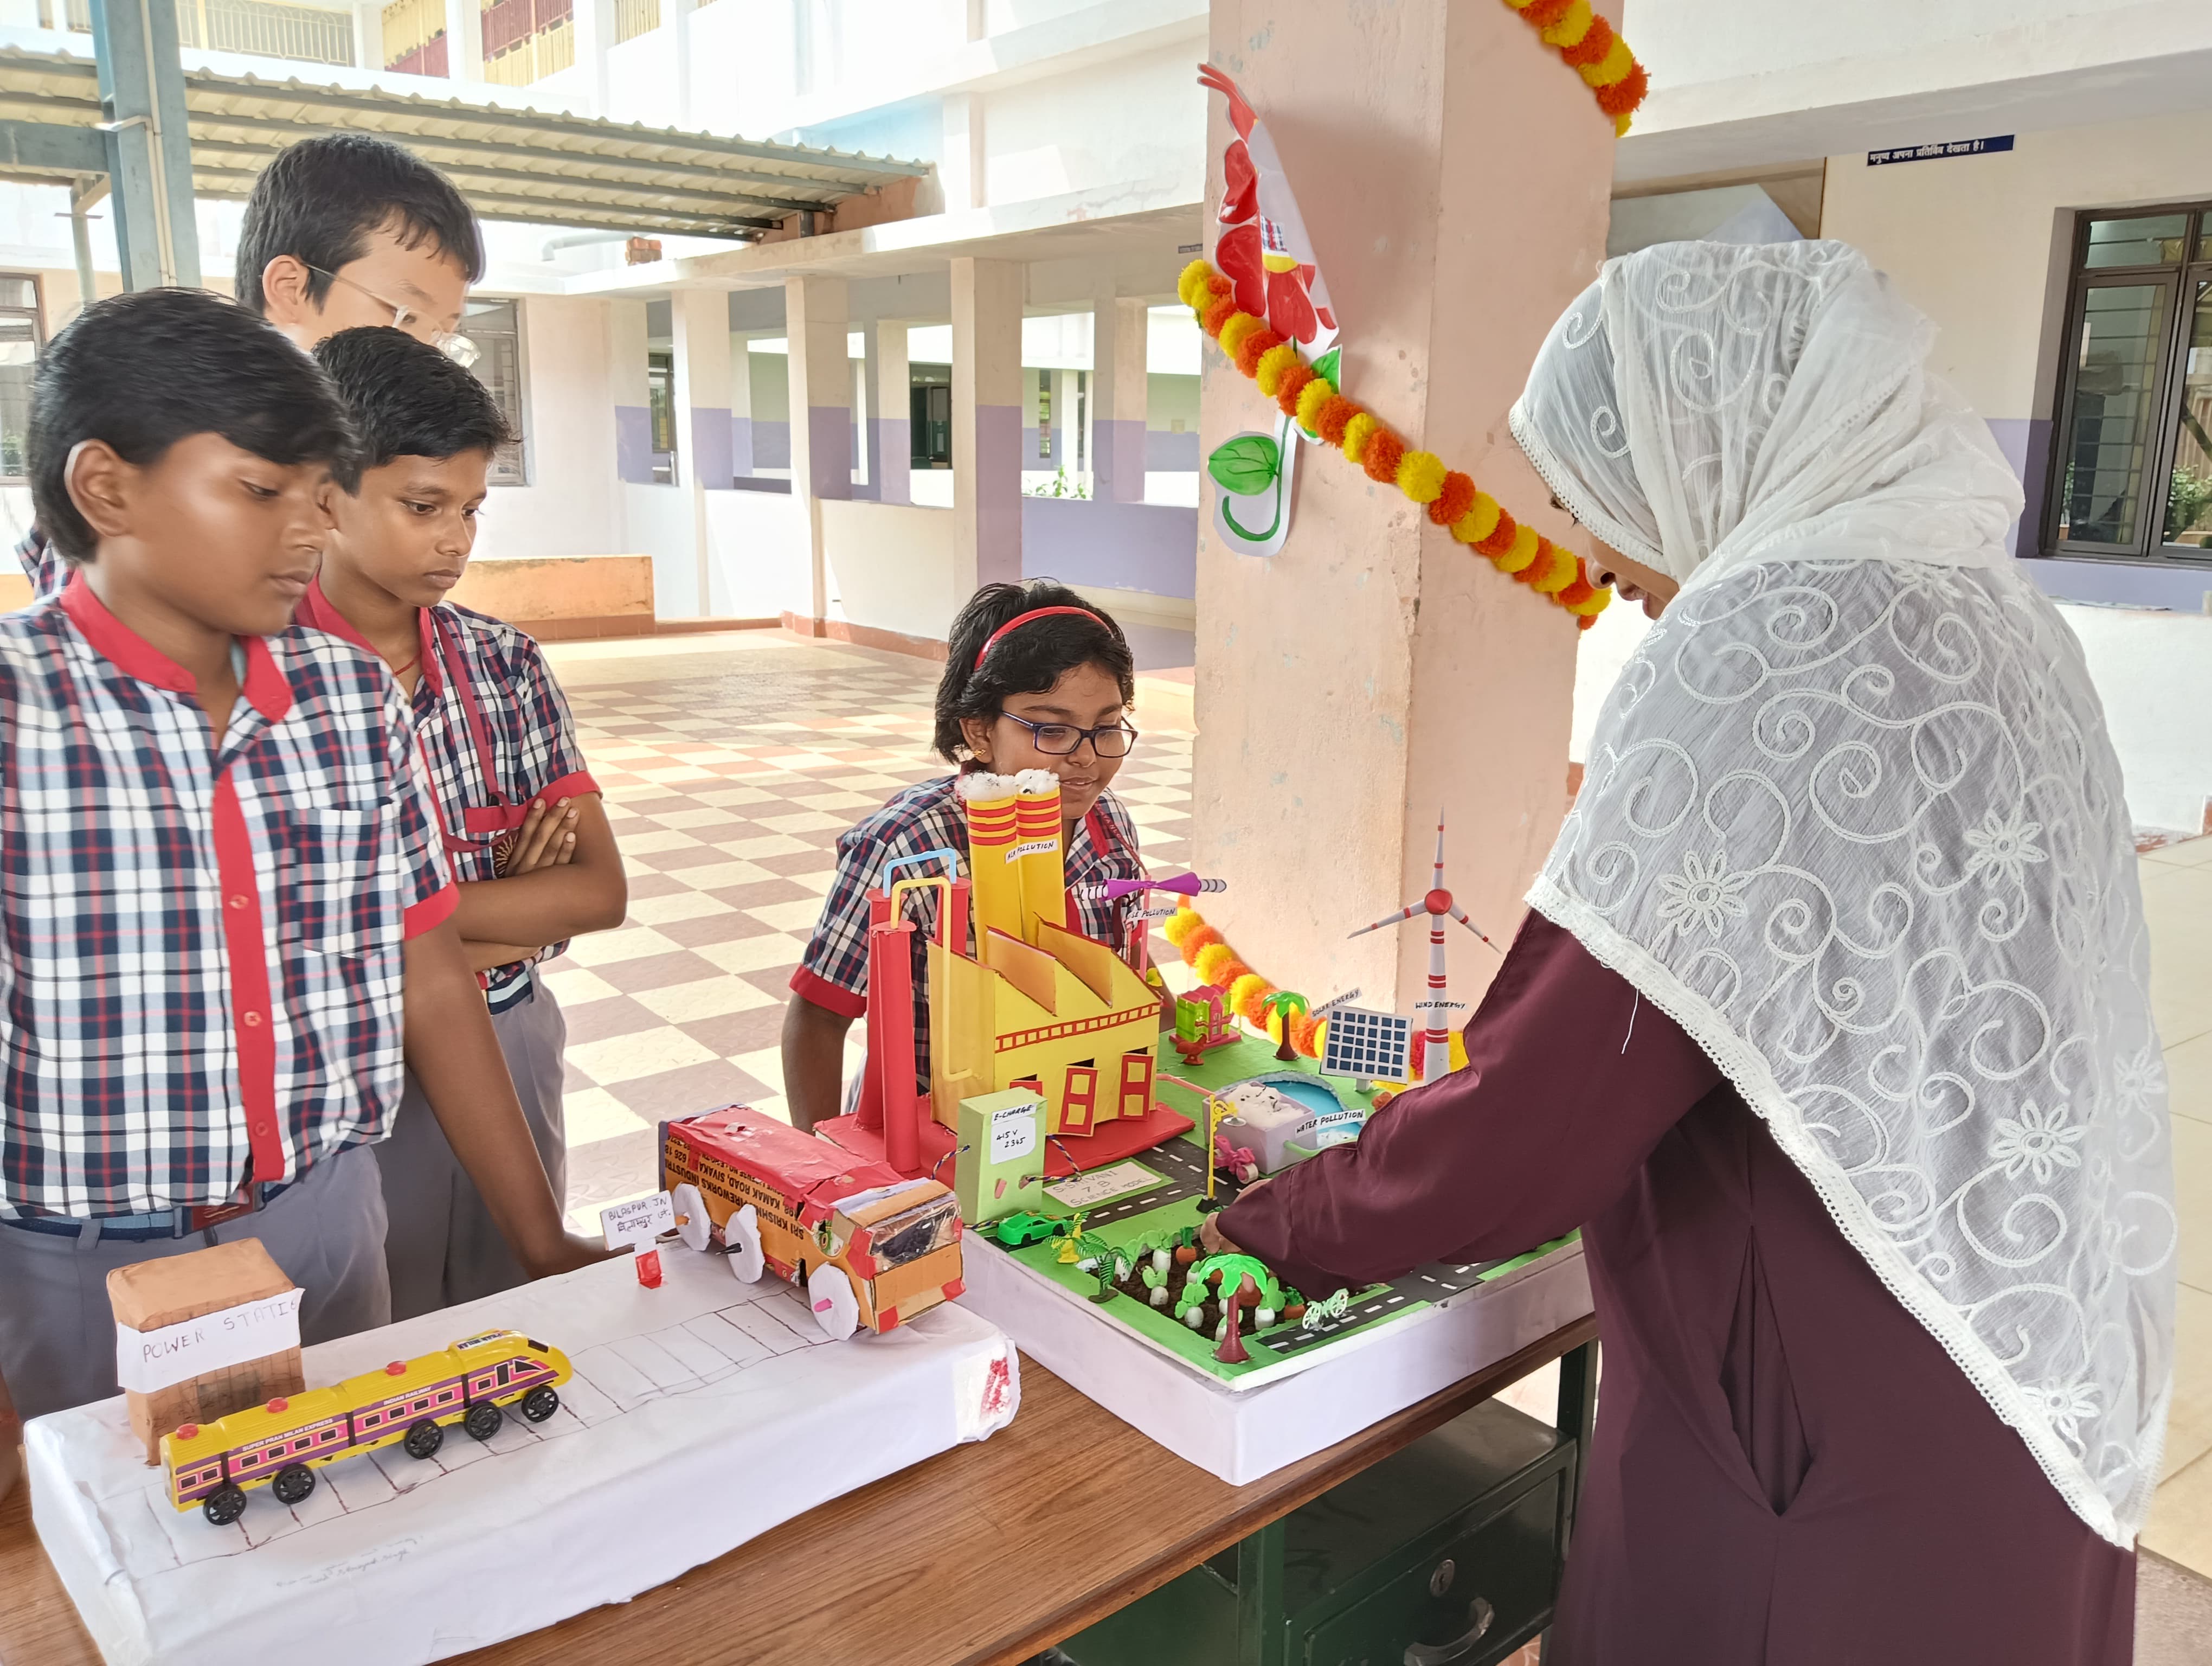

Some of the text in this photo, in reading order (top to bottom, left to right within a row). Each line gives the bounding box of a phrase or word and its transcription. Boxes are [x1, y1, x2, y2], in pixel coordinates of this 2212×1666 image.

[1892, 149, 1913, 160] अपना
[1947, 142, 1970, 153] देखता
[1017, 841, 1054, 854] POLLUTION
[1141, 908, 1175, 918] POLLUTION
[1312, 989, 1360, 1017] SOLAR ENERGY
[1433, 1002, 1465, 1010] ENERGY
[1296, 1111, 1364, 1133] WATER POLLUTION
[1005, 1137, 1026, 1148] 2345
[701, 1177, 745, 1208] IREWORKS
[753, 1188, 780, 1210] KAMAK
[1070, 1177, 1153, 1206] SCIENCE MODEL
[755, 1204, 788, 1231] KRISHN
[790, 1223, 804, 1240] SRI
[143, 1328, 205, 1362] POWER
[383, 1386, 432, 1406] INDIAN RAILWAY
[242, 1418, 334, 1452] SUPER PRAN MILAN EXPRESS
